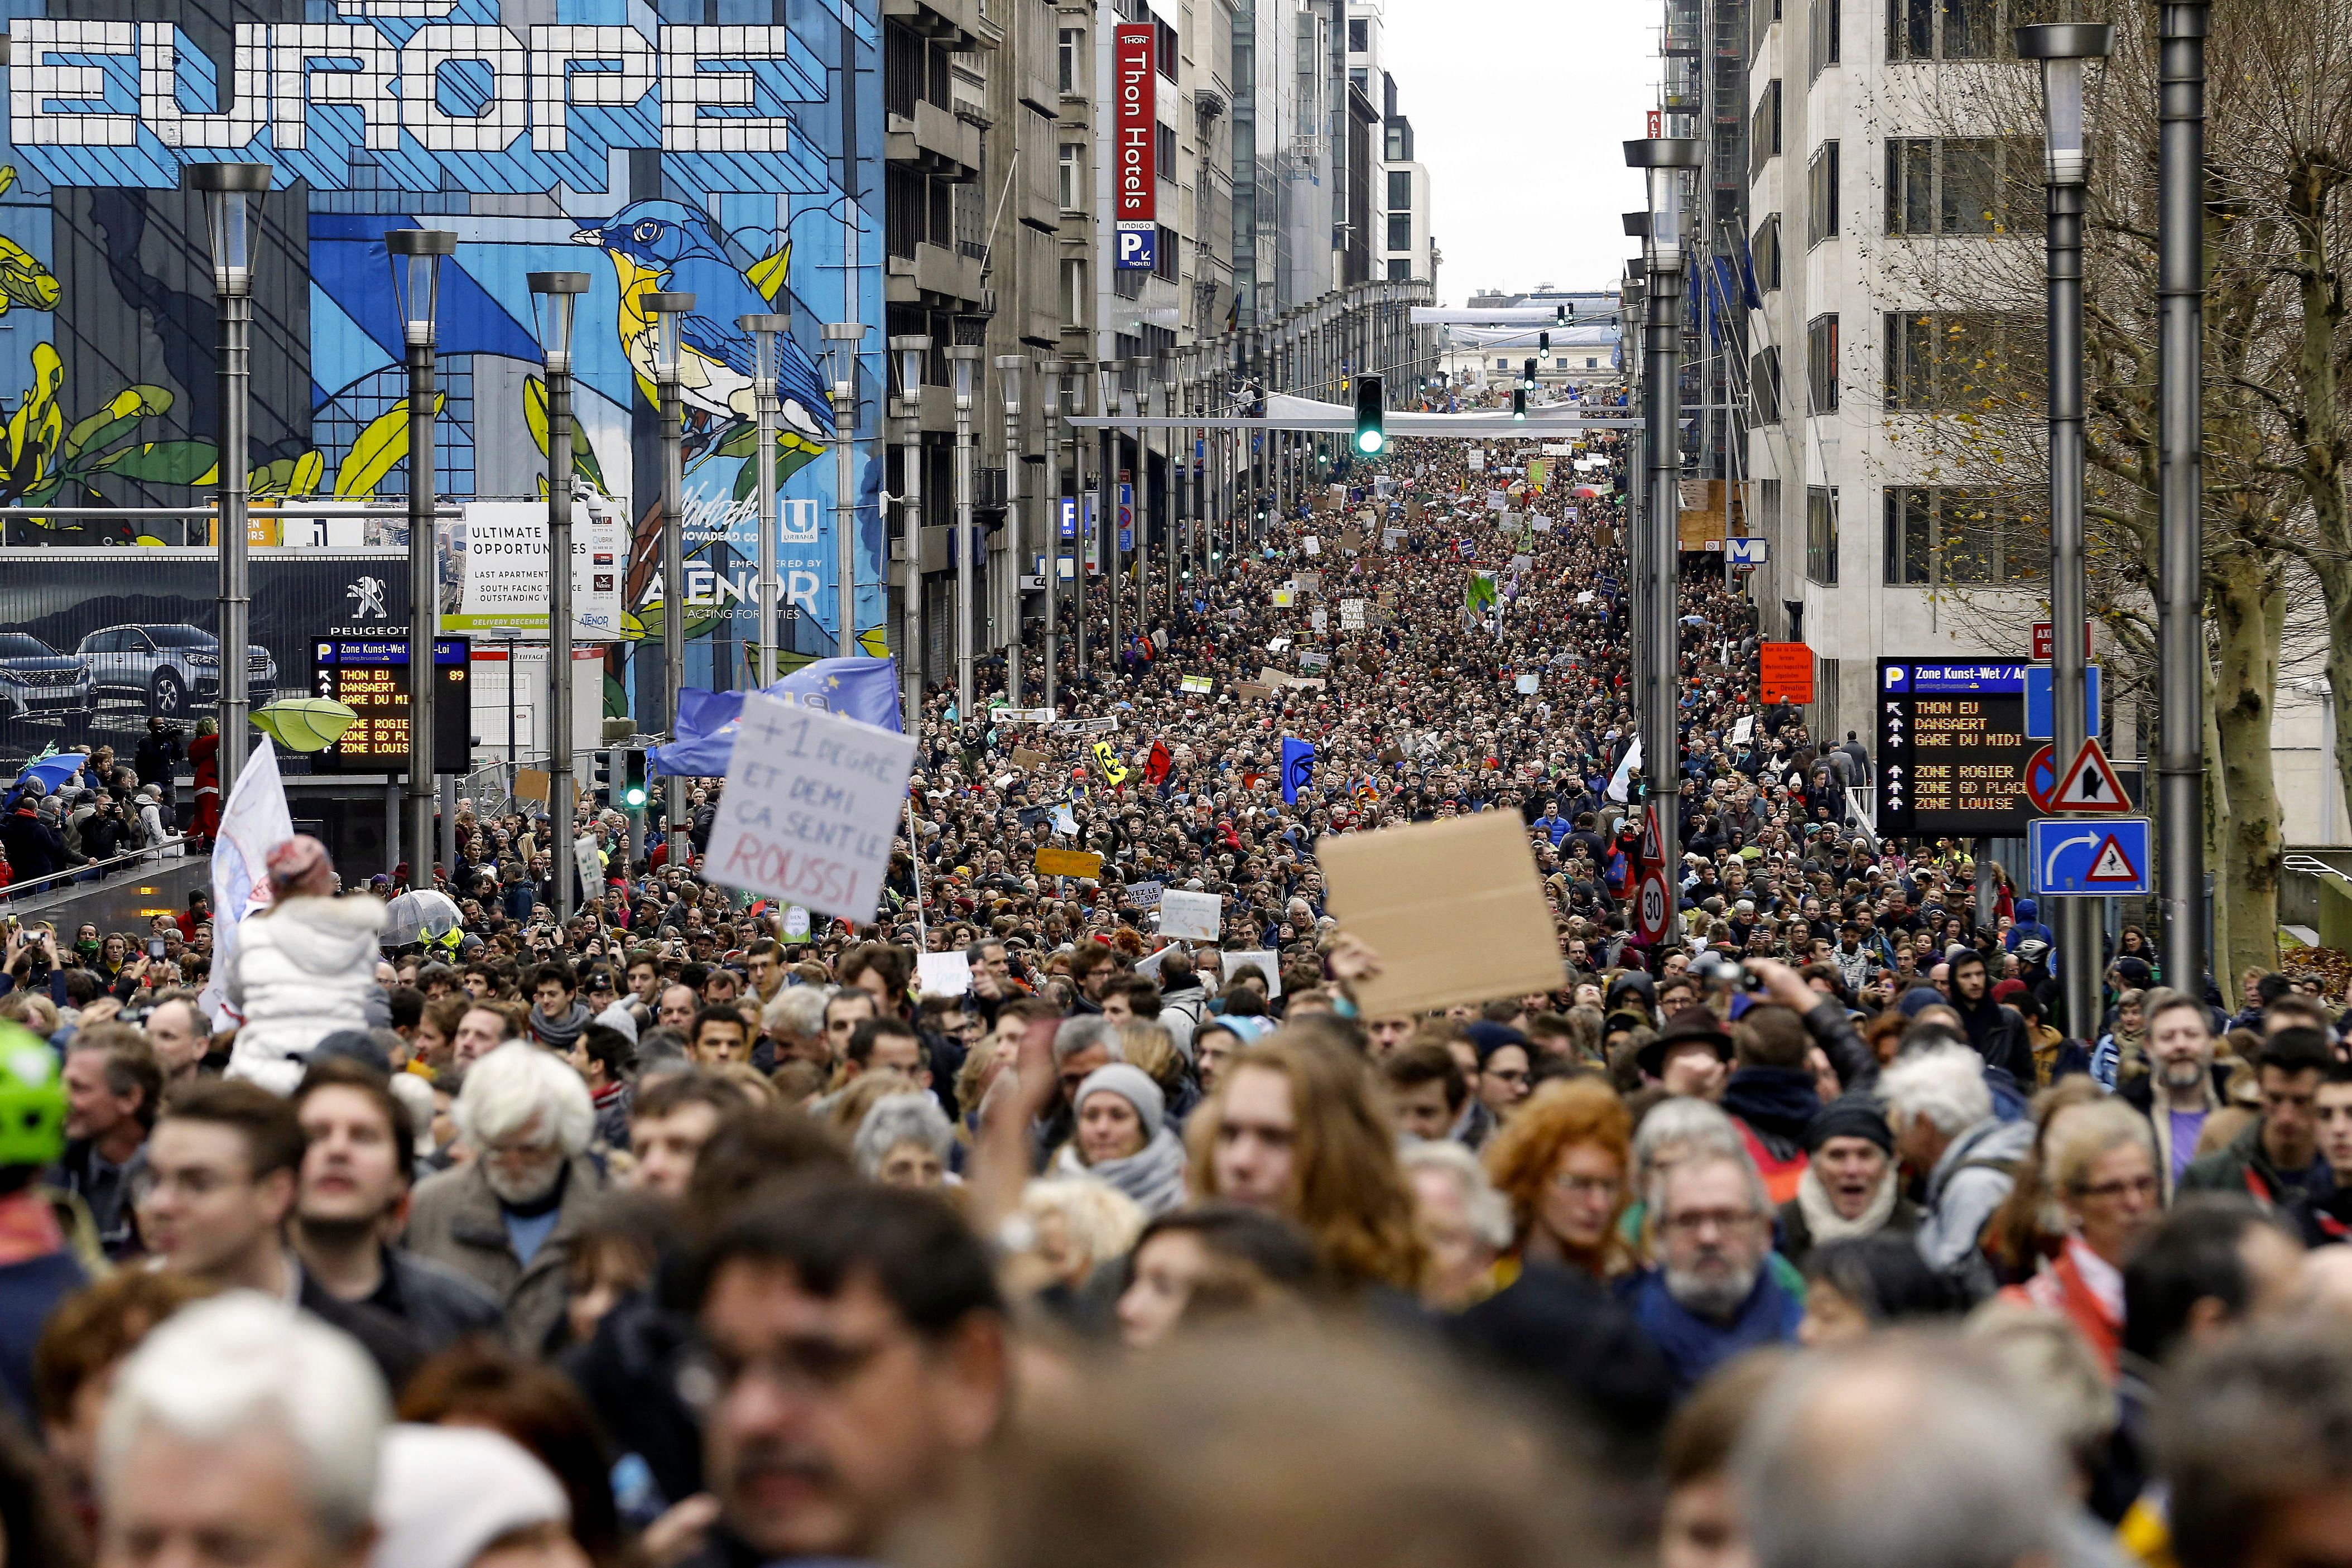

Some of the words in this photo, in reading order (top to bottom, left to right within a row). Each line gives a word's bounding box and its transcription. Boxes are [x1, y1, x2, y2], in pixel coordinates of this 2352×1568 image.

[1121, 35, 1149, 44] THON
[10, 18, 787, 152] EUROPE
[1124, 51, 1147, 116] Thon
[1124, 128, 1147, 210] Hotels
[1120, 233, 1142, 261] P
[472, 527, 541, 538] ULTIMATE
[473, 543, 586, 555] OPPORTUNES
[729, 560, 803, 568] EMPOERED
[687, 609, 732, 619] ACTING
[736, 609, 759, 619] FOR
[777, 609, 800, 620] TIES
[1341, 620, 1365, 629] PEOPLE
[330, 626, 409, 636] PEUGEOT
[2037, 629, 2052, 639] AX
[318, 644, 331, 660] P
[341, 644, 360, 653] Zone
[363, 644, 406, 653] Kunst-Wet
[340, 670, 368, 680] THON
[374, 670, 389, 680] EU
[449, 671, 464, 681] 89
[1886, 667, 1904, 689] P
[1916, 667, 1941, 679] Zone
[1944, 667, 2000, 679] Kunst-Wet
[340, 682, 396, 692] DANSAERT
[340, 695, 368, 705] GARE
[374, 695, 389, 705] DU
[396, 695, 408, 705] MI
[1915, 702, 1952, 714] THON
[1959, 702, 1979, 714] EU
[374, 719, 409, 729] ROGIE
[1915, 718, 1987, 730] DANSAERT
[341, 731, 368, 741] ZONE
[374, 731, 389, 741] GD
[1915, 734, 1952, 746] GARE
[1959, 734, 1978, 746] DU
[1986, 734, 2022, 746] MIDI
[340, 743, 368, 753] ZONE
[374, 743, 409, 753] LOUIS
[1915, 766, 1952, 778] ZONE
[1959, 766, 2014, 778] ROGIER
[742, 761, 782, 790] ET
[790, 775, 857, 814] DEMI
[1915, 782, 1952, 794] ZONE
[1959, 782, 1978, 794] GD
[1915, 797, 1952, 810] ZONE
[1959, 797, 2014, 810] LOUISE
[724, 833, 860, 907] ROUSSI
[1645, 891, 1661, 921] 30
